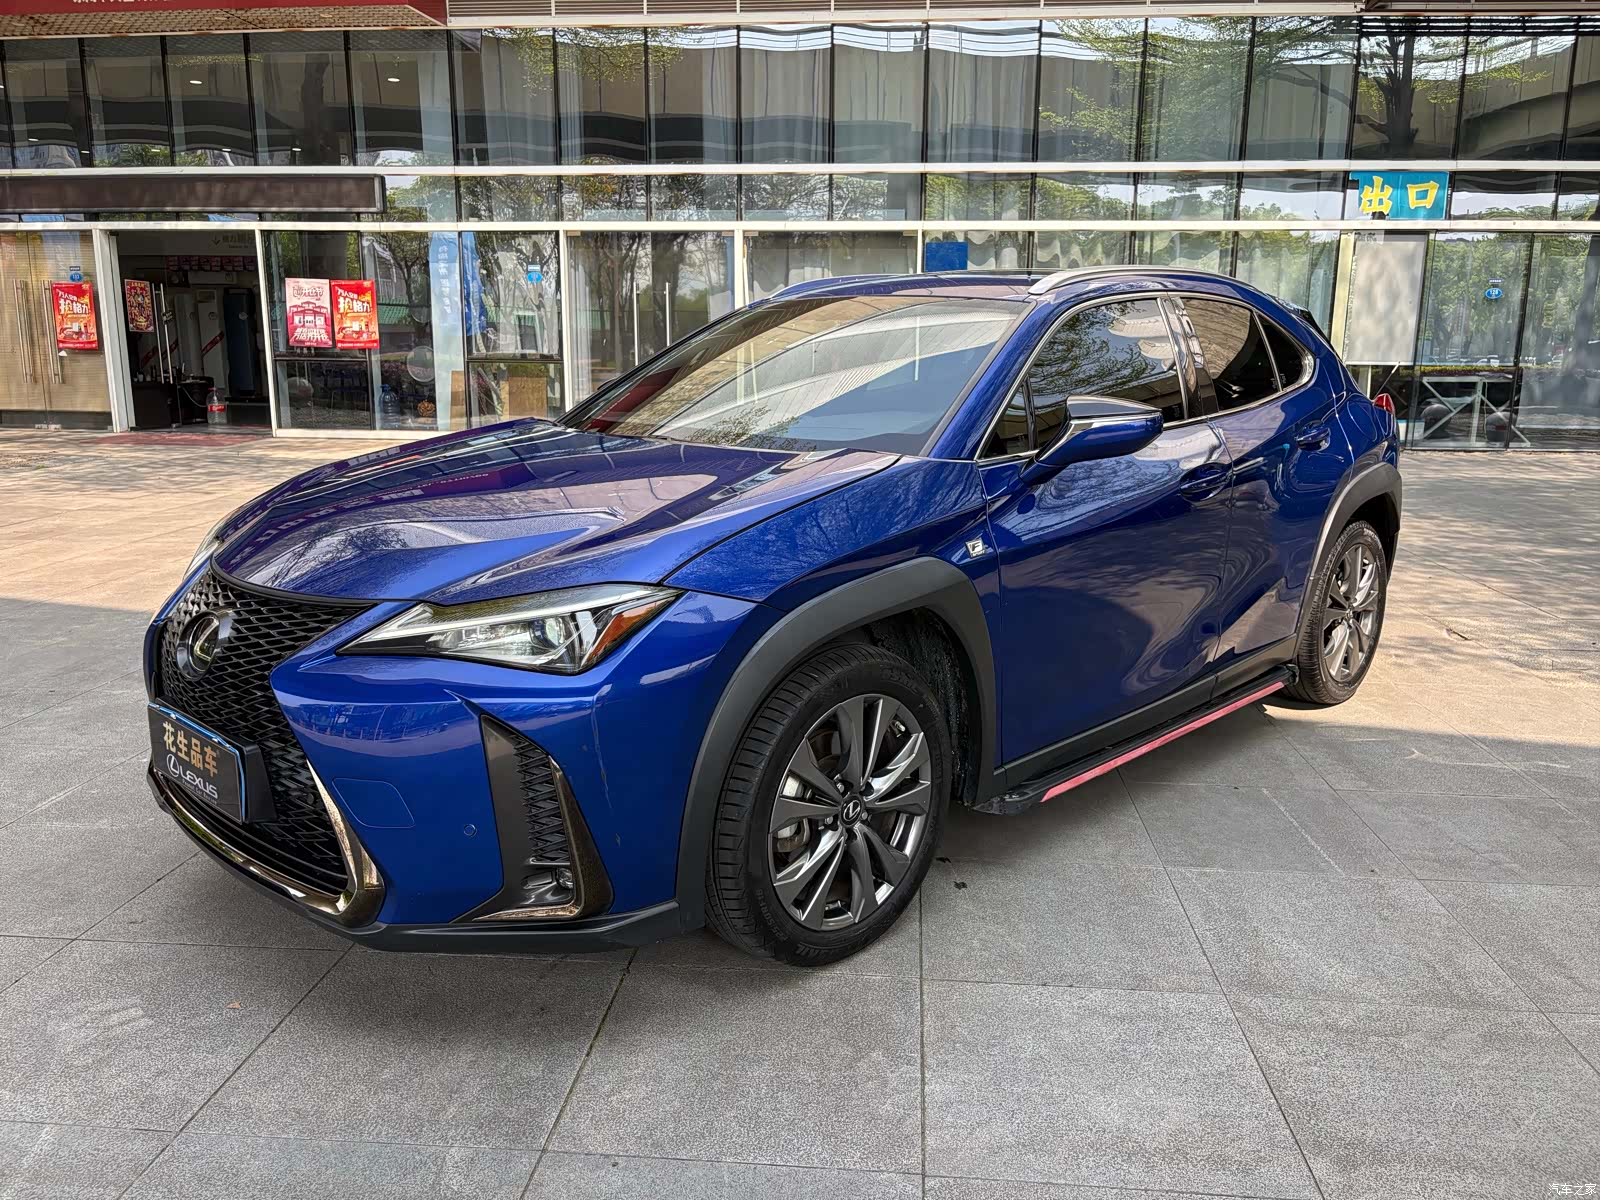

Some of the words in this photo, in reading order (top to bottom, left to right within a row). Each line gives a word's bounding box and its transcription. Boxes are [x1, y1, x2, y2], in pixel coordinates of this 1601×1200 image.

[1359, 175, 1440, 216] 出口
[163, 721, 218, 777] 花生品车
[180, 765, 218, 799] LEXUS
